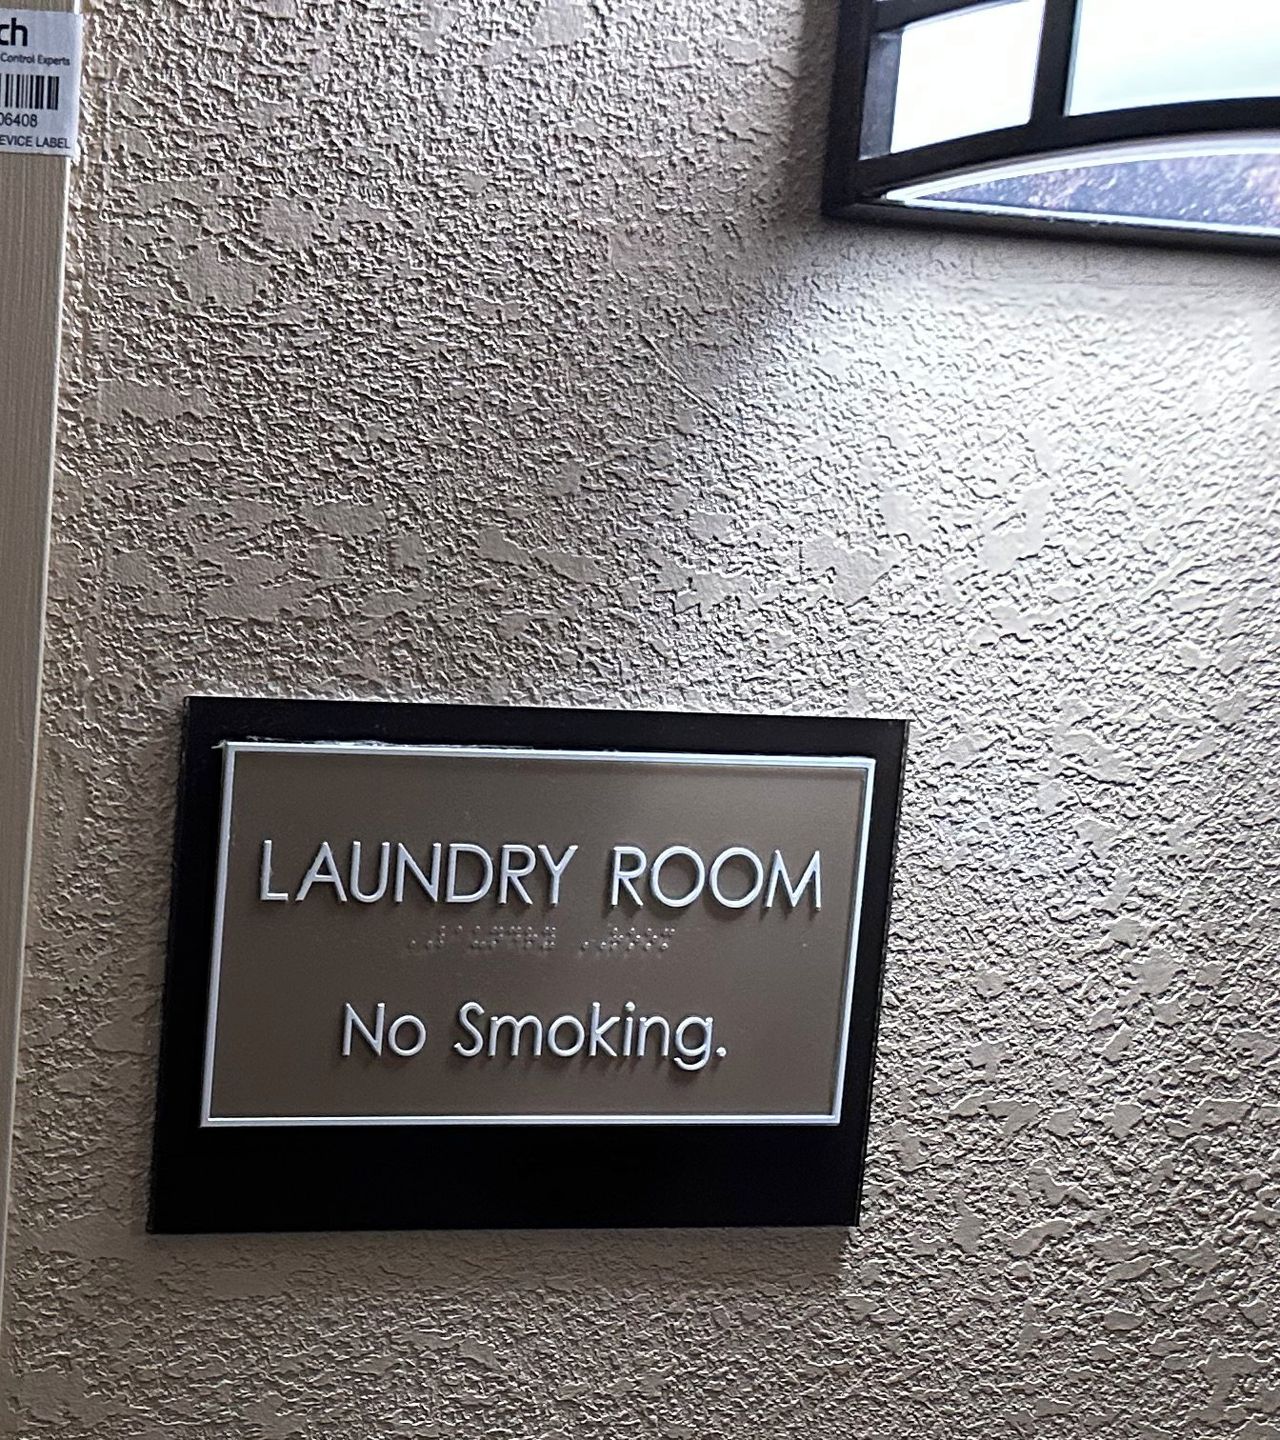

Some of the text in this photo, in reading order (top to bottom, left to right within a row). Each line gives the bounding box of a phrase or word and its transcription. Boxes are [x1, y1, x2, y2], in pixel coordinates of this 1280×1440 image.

[0, 53, 35, 64] Control
[37, 54, 71, 66] Experts
[36, 137, 71, 149] LABEL
[259, 839, 822, 911] LAUNDRY ROOM
[341, 1001, 729, 1072] No Smoking.
